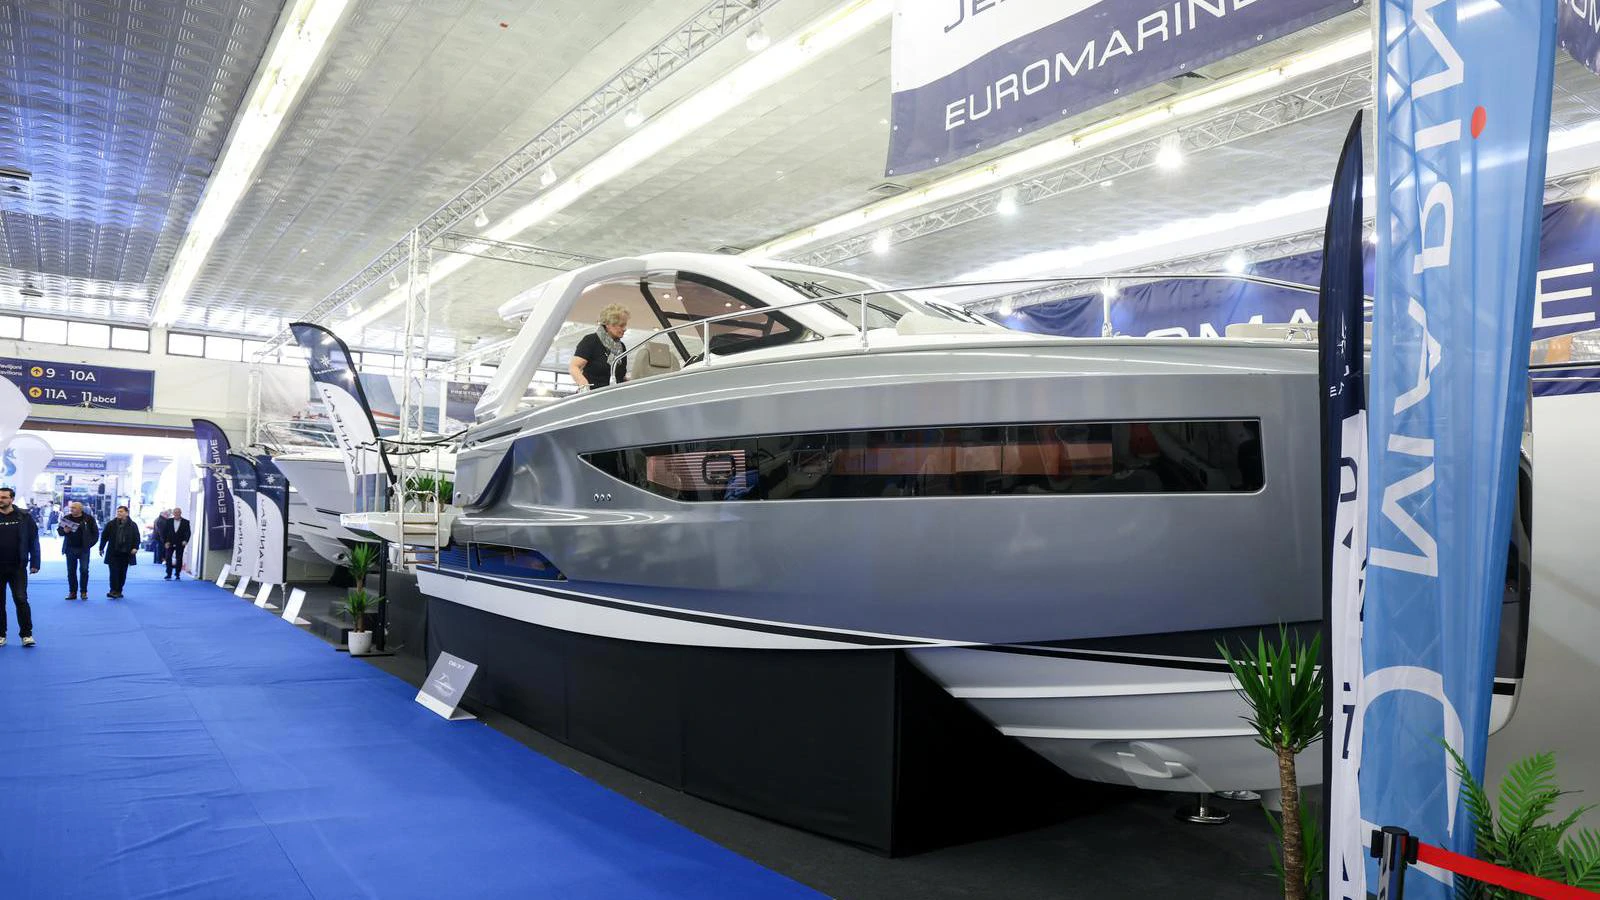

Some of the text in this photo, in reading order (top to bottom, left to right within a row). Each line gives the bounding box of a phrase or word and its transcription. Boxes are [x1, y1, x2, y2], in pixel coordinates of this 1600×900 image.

[46, 368, 56, 379] 9
[69, 370, 97, 382] 10A
[44, 388, 67, 400] 11A
[81, 391, 117, 404] 11abcd
